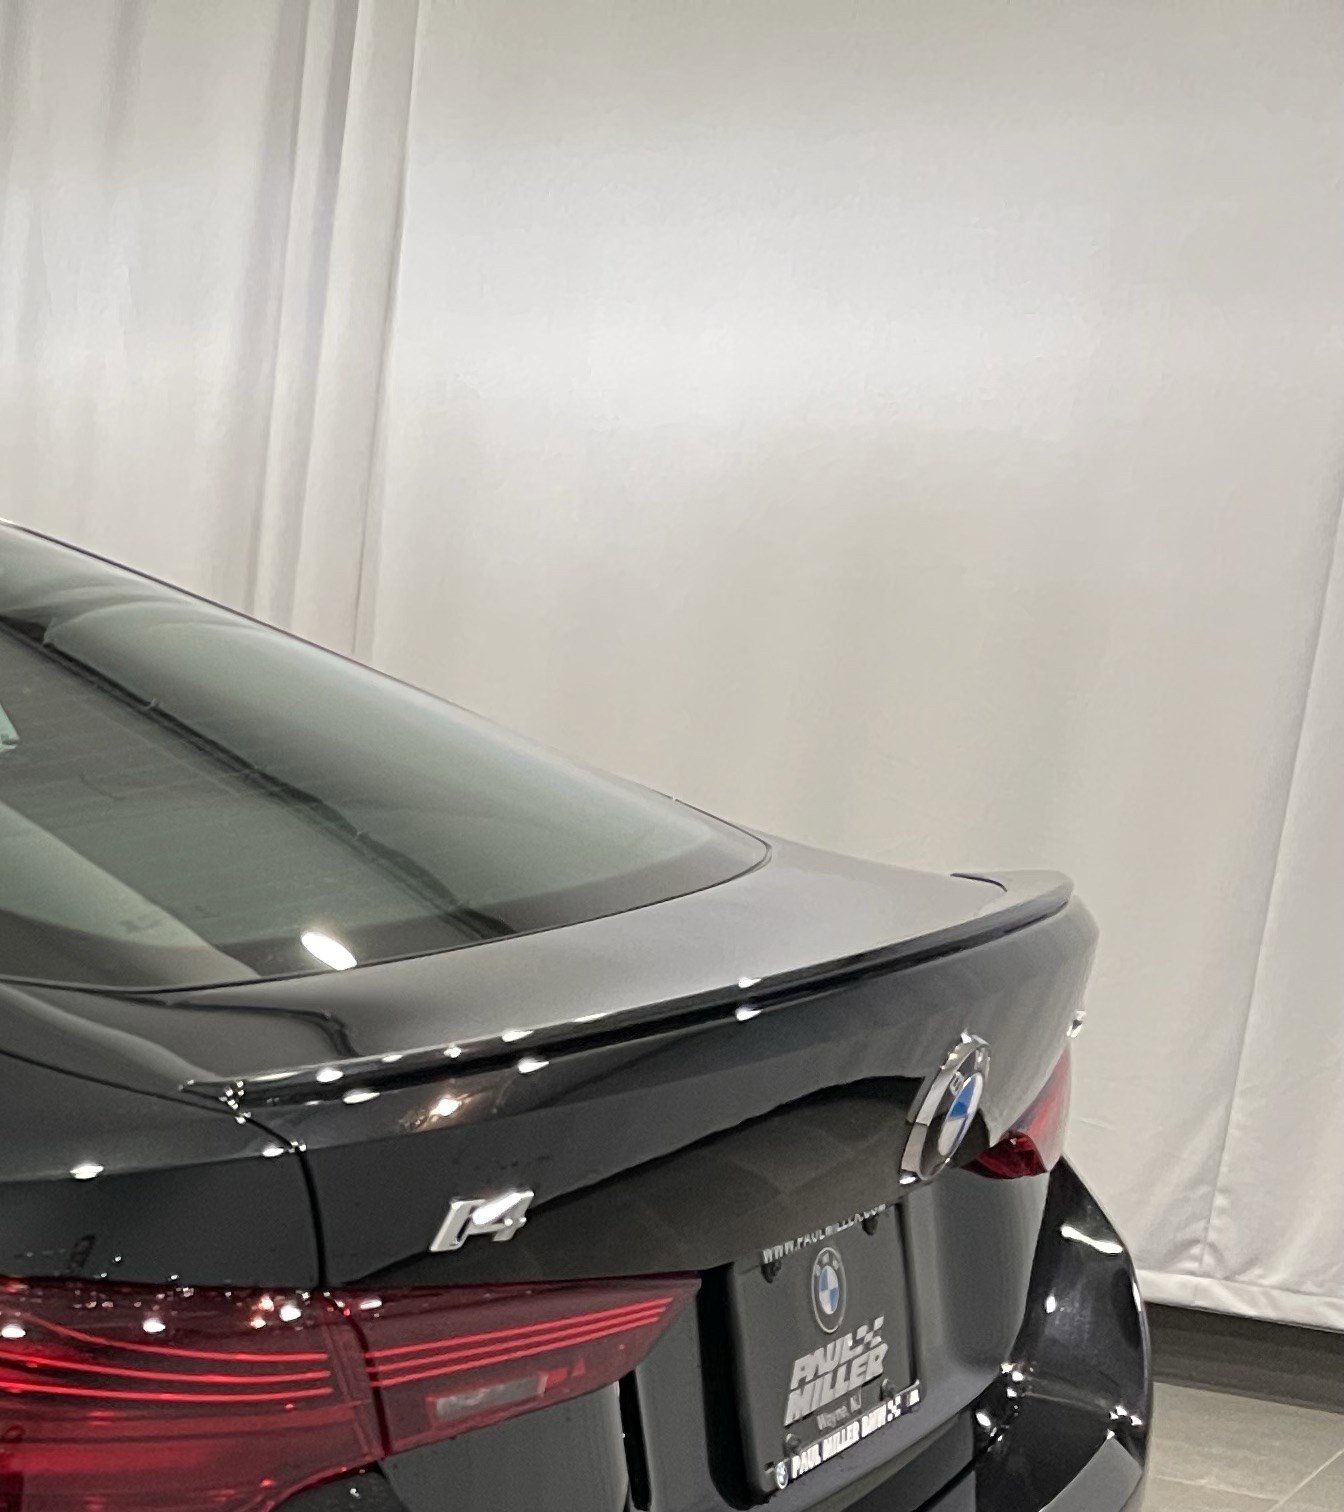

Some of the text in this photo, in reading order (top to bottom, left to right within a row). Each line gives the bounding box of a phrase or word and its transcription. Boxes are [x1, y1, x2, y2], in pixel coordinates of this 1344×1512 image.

[784, 1342, 889, 1427] MILLER
[790, 1332, 865, 1391] PAUL
[822, 1421, 860, 1461] MILLER
